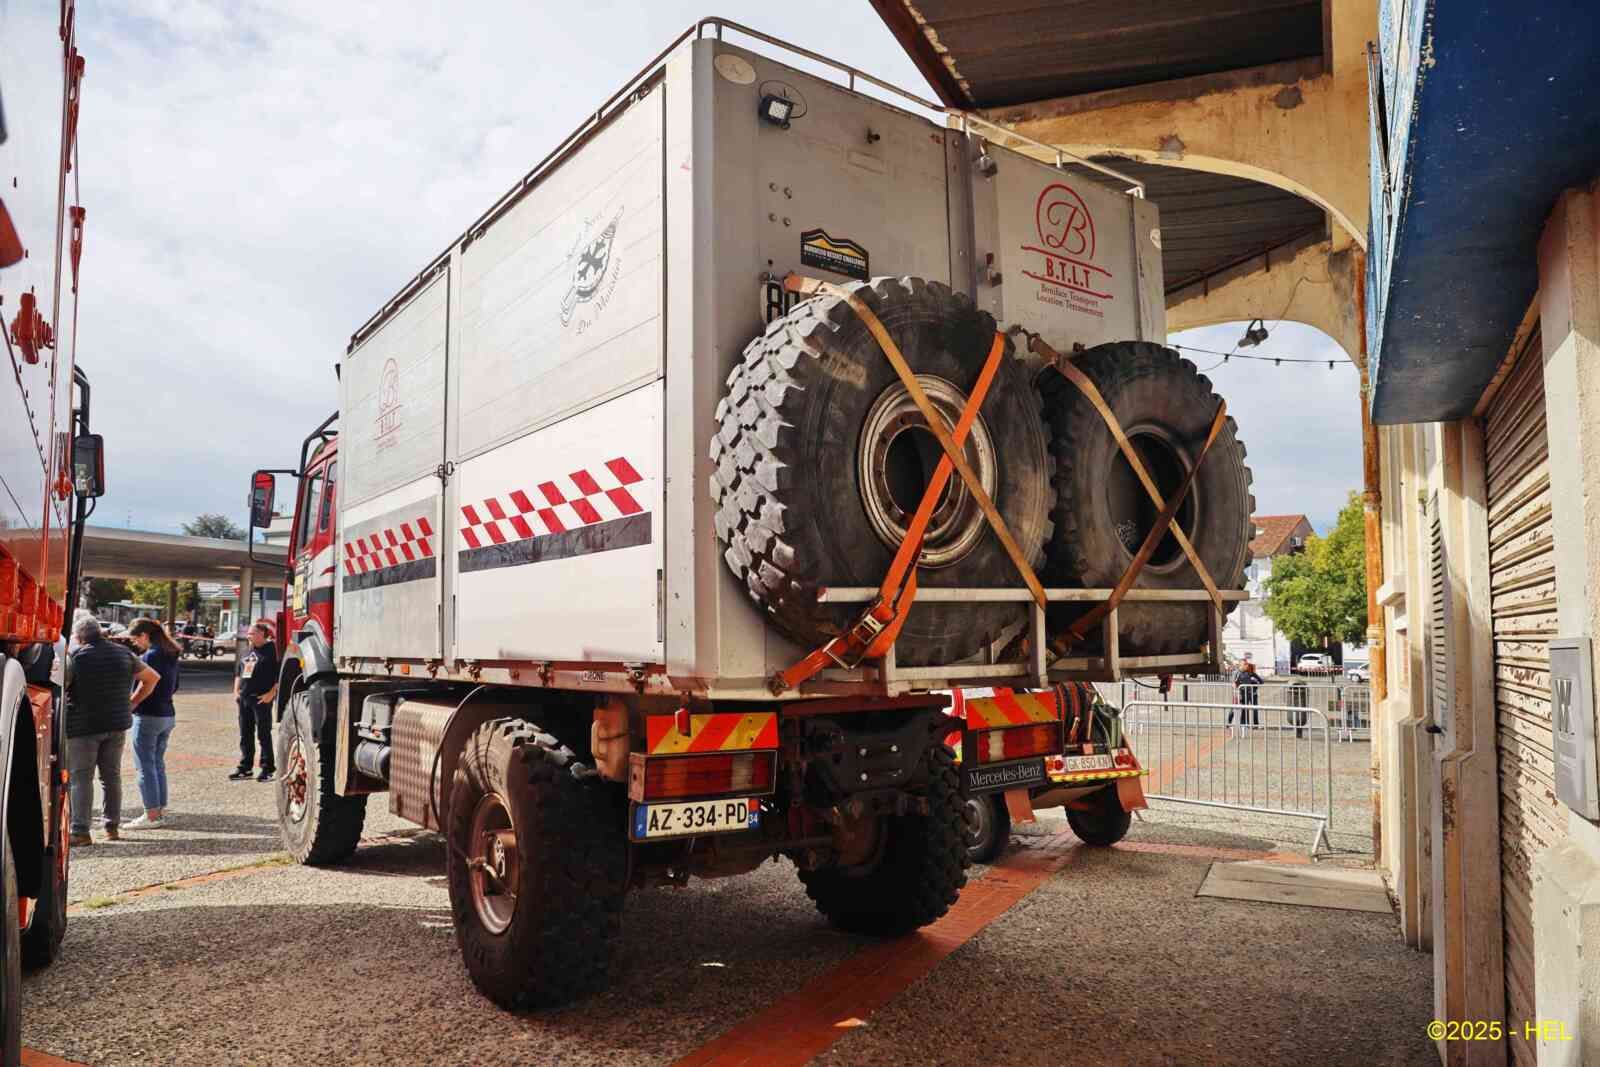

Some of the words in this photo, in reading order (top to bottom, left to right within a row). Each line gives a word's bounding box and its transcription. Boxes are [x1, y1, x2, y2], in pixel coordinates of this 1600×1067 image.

[1046, 256, 1090, 289] B.T.L.T
[969, 764, 1041, 787] Mercedes-Benz
[647, 802, 748, 832] AZ-334-PD
